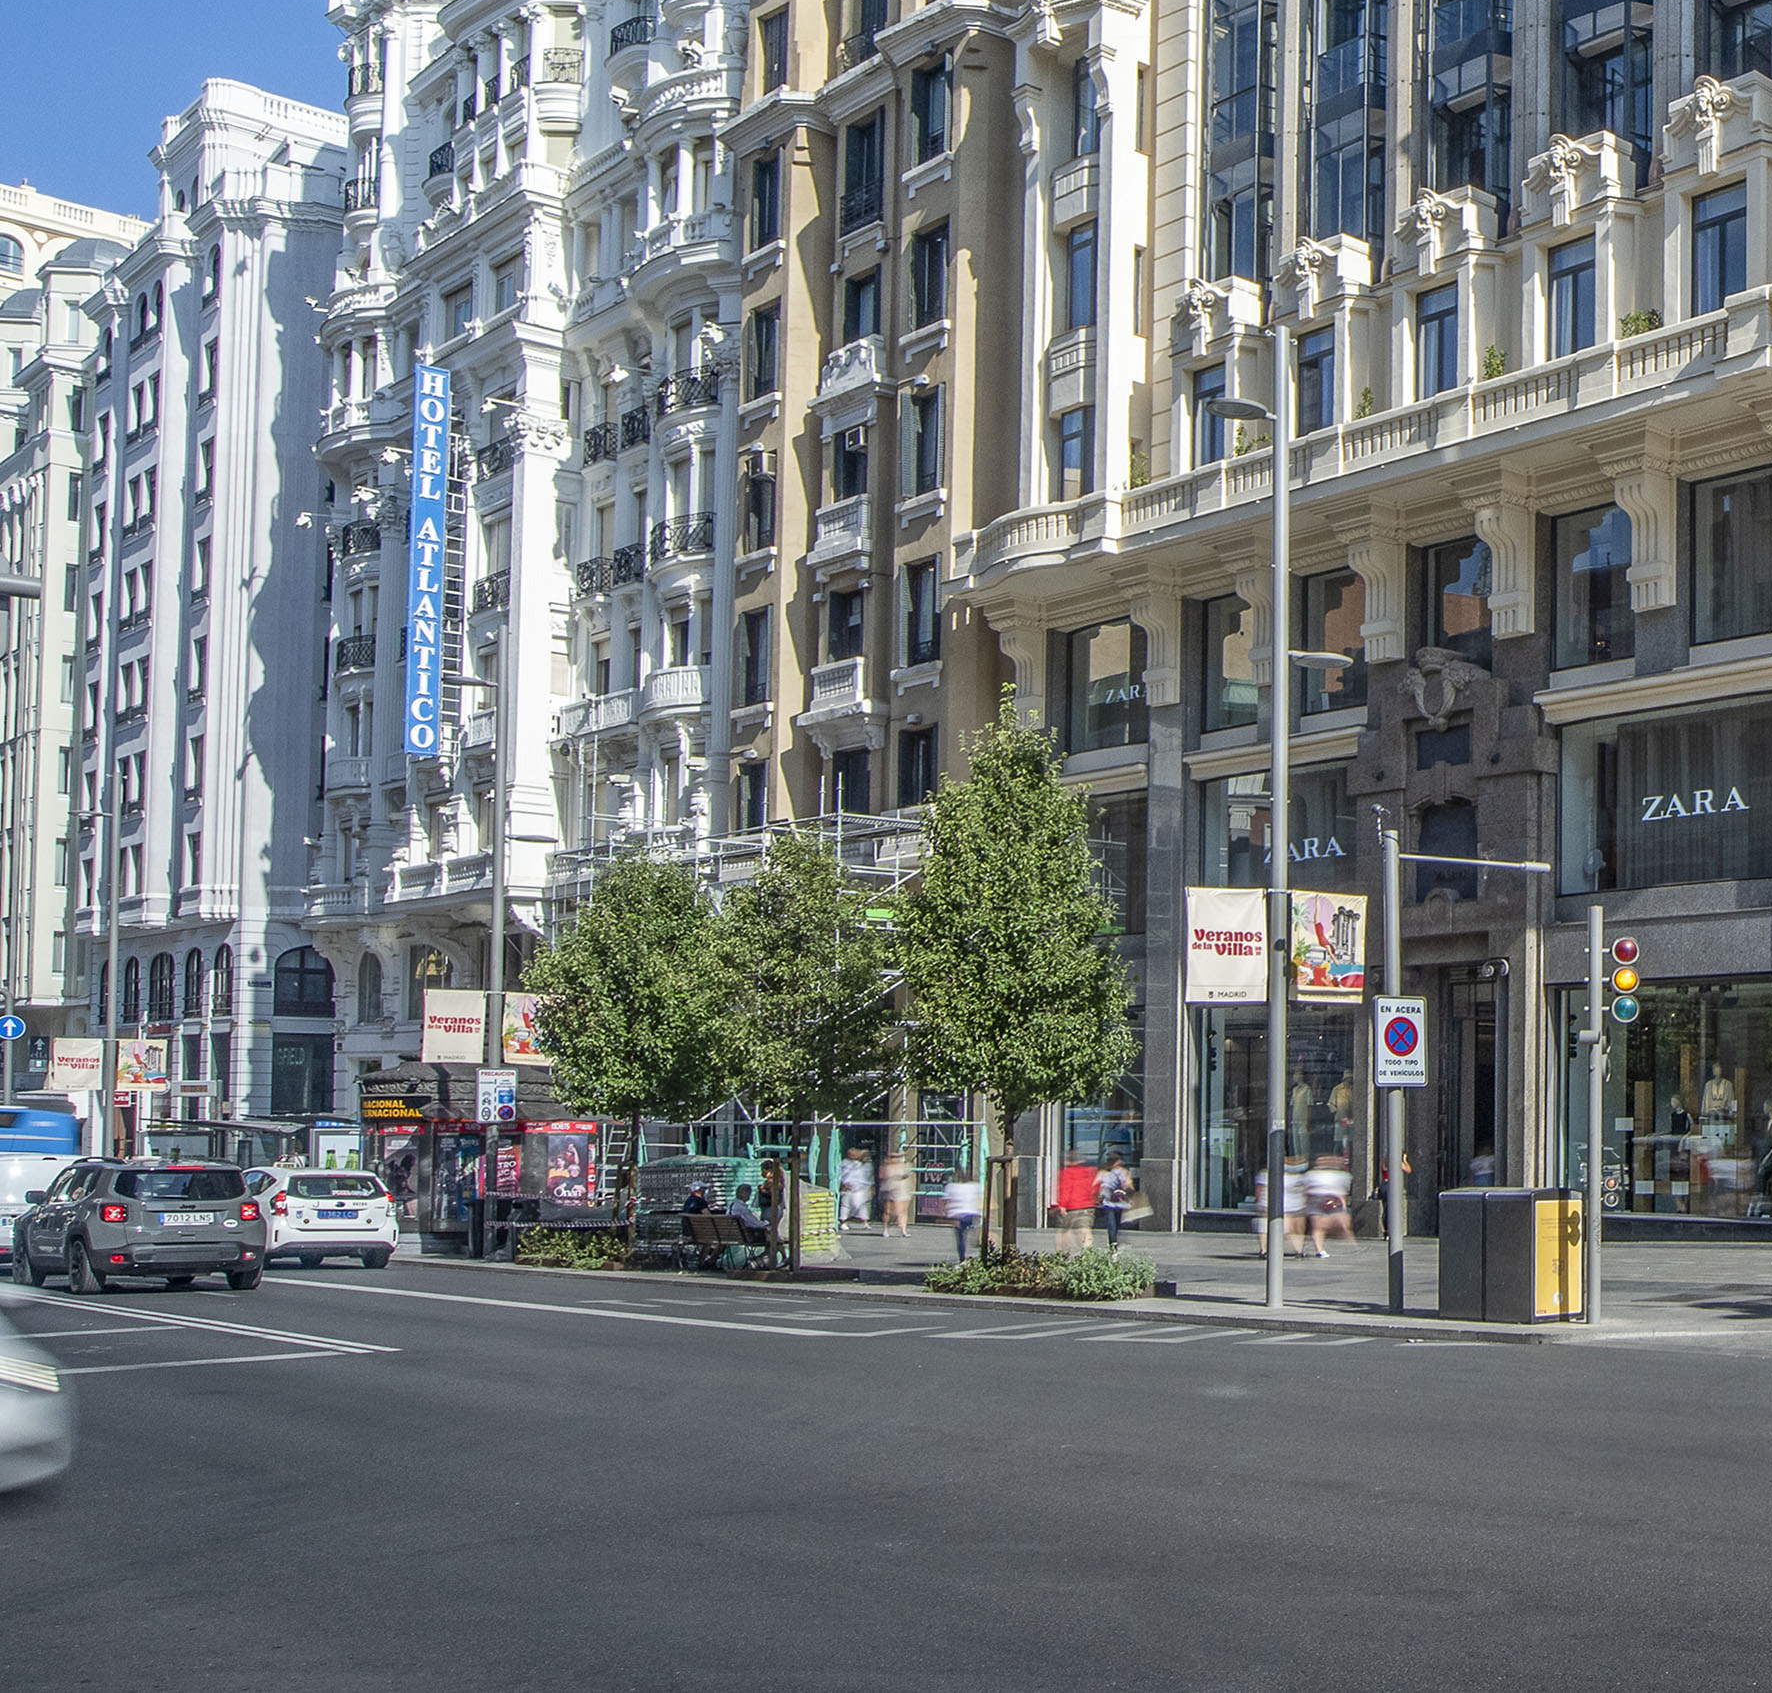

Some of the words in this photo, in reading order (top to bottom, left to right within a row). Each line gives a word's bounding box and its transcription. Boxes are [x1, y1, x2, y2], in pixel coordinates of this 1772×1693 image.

[418, 370, 446, 501] HOTEL
[409, 515, 441, 749] ATLANTICO
[1105, 683, 1147, 704] ZAR
[1641, 786, 1750, 822] ZARA
[1194, 928, 1263, 943] Veranos
[1192, 941, 1201, 950] de
[1203, 941, 1213, 951] la
[1214, 942, 1254, 956] Villa
[1380, 1005, 1391, 1013] EN
[1395, 1006, 1422, 1014] ACERA
[429, 1015, 481, 1025] Veranos
[443, 1024, 473, 1034] Villa
[57, 1056, 101, 1064] Veranos
[71, 1062, 95, 1070] Villa
[1390, 1069, 1424, 1077] VEHÍCULOS
[165, 1213, 191, 1222] 7012
[193, 1213, 212, 1222] LNS
